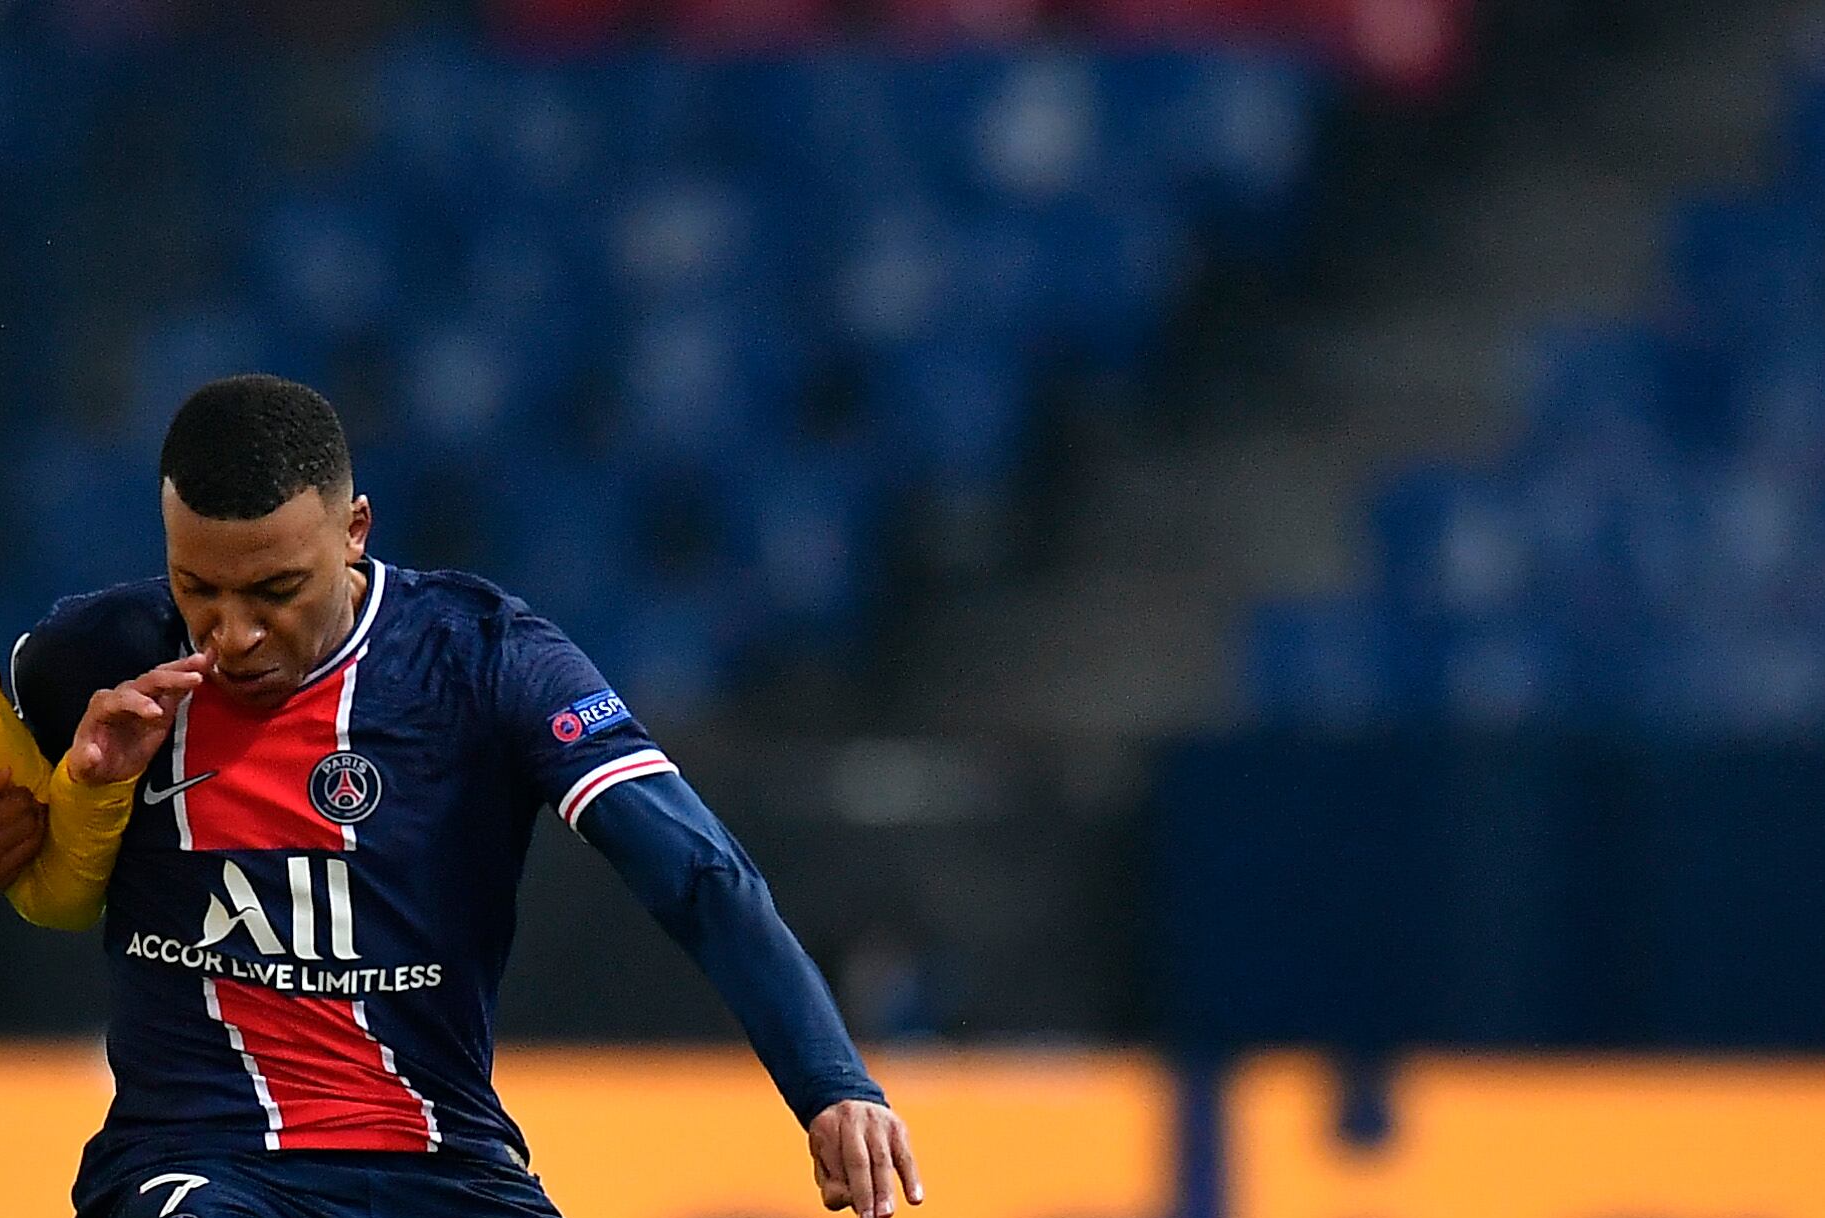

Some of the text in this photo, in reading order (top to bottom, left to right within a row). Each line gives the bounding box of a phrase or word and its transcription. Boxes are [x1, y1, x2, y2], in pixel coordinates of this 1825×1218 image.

[321, 757, 368, 774] PARIS
[126, 931, 442, 994] ACCOR LIVE LIMITLESS
[139, 1173, 210, 1218] 7
